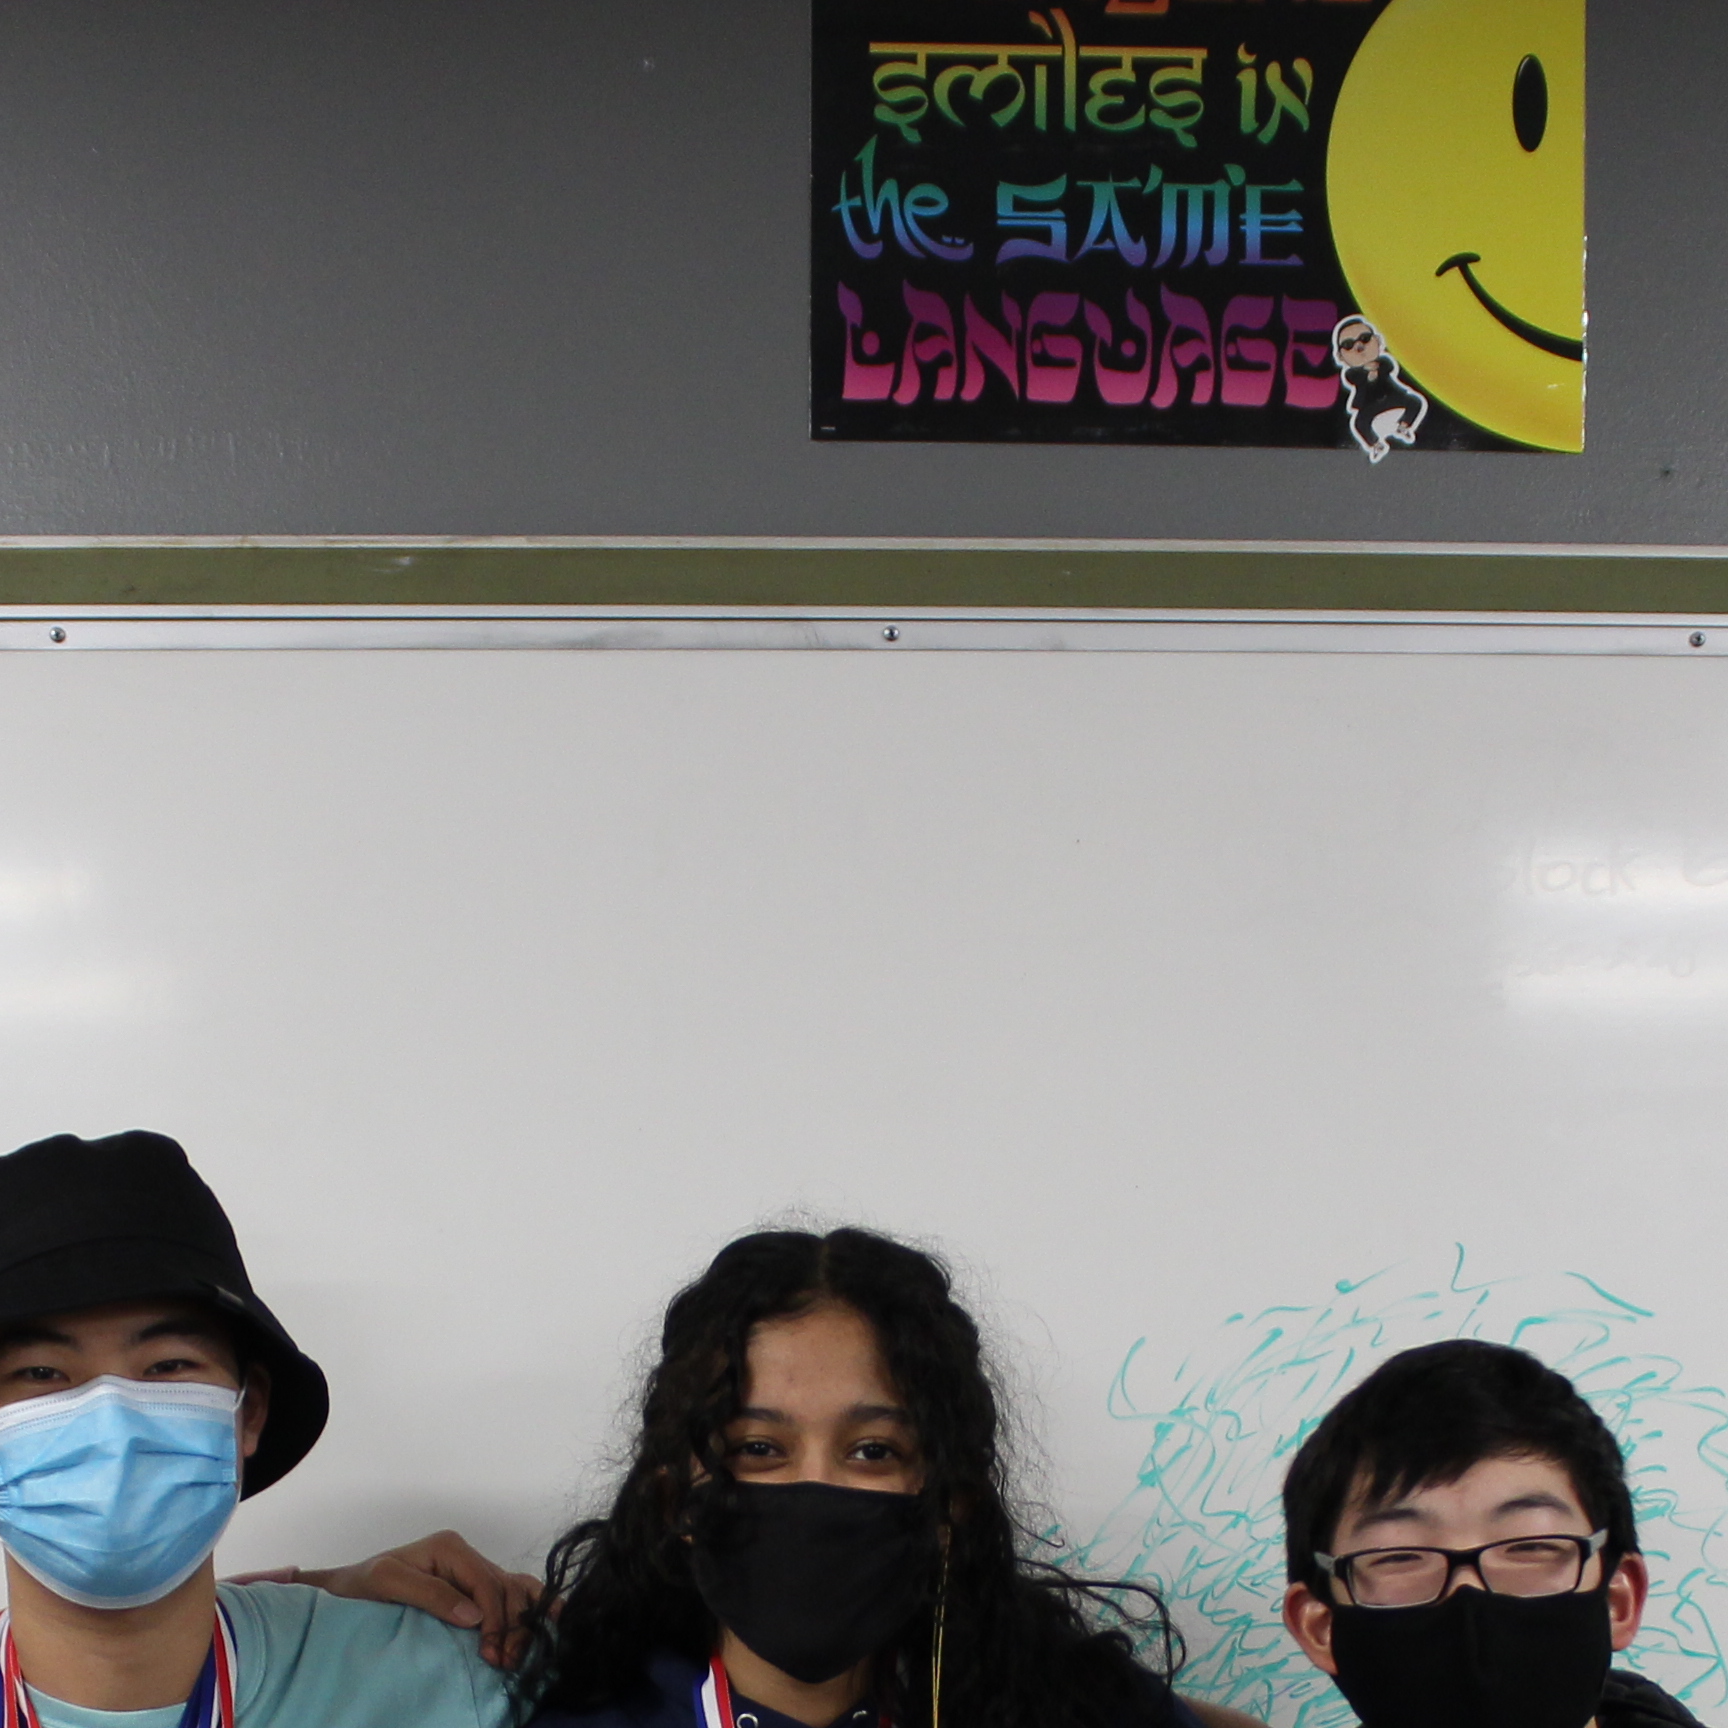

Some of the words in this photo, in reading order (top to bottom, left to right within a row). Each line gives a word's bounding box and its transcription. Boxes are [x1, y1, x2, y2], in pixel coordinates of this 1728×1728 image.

[831, 135, 973, 260] the
[996, 164, 1304, 268] SAME
[838, 280, 1341, 410] LANGUAGE
